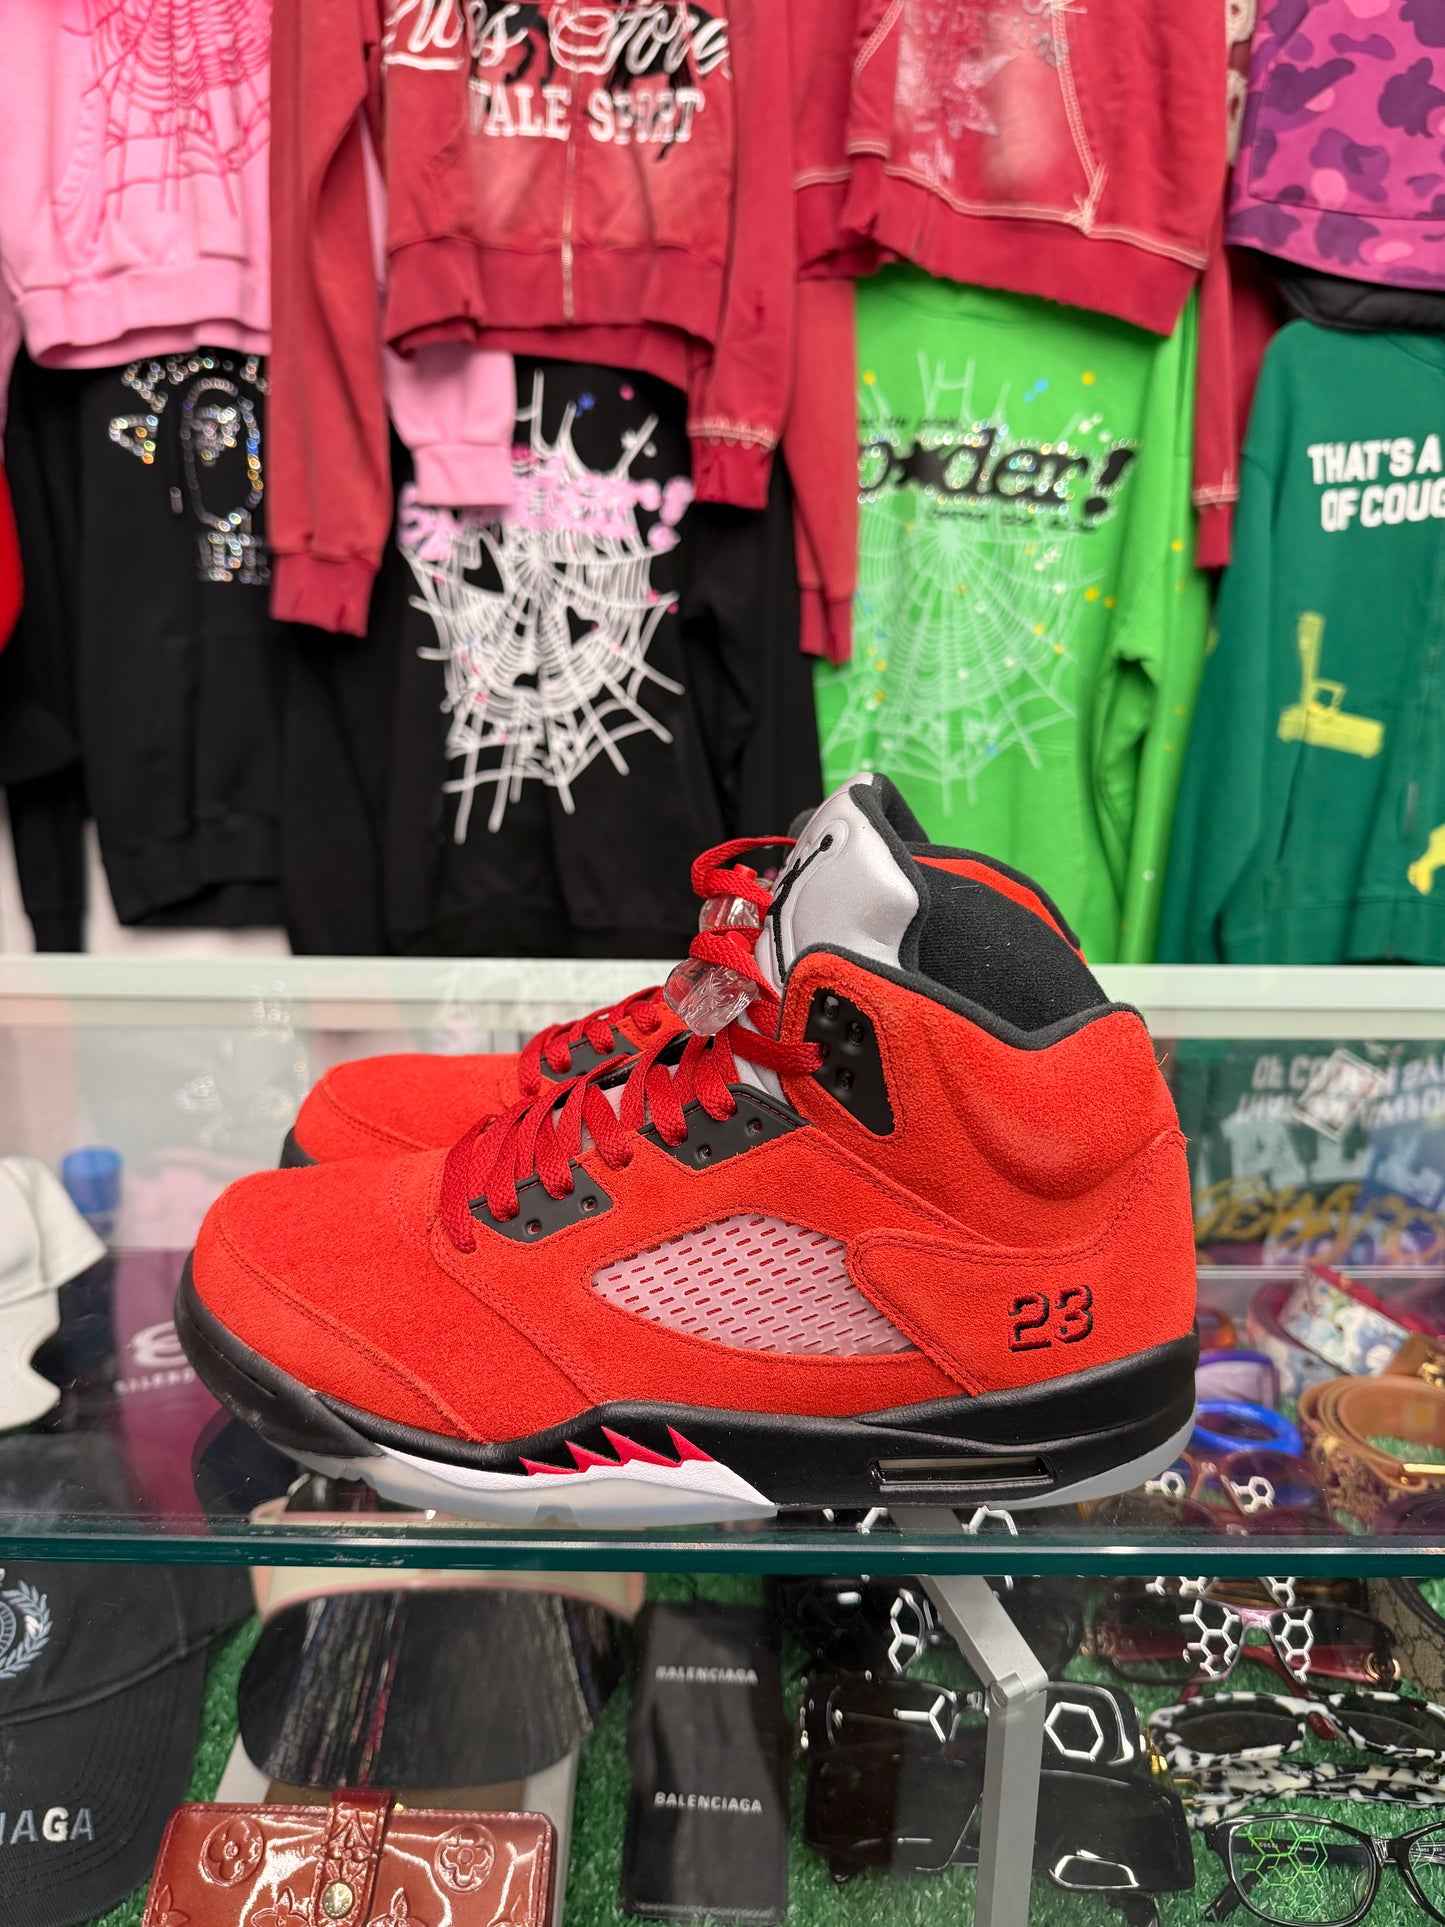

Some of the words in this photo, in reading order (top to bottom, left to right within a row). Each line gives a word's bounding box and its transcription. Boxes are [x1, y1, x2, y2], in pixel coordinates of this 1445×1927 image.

[1306, 437, 1415, 485] THAT'S
[1415, 433, 1443, 475] A
[1320, 487, 1360, 533] OF
[1007, 1284, 1094, 1353] 23
[655, 1666, 758, 1683] BALENCIAGA
[654, 1792, 762, 1813] BALENCIAGA
